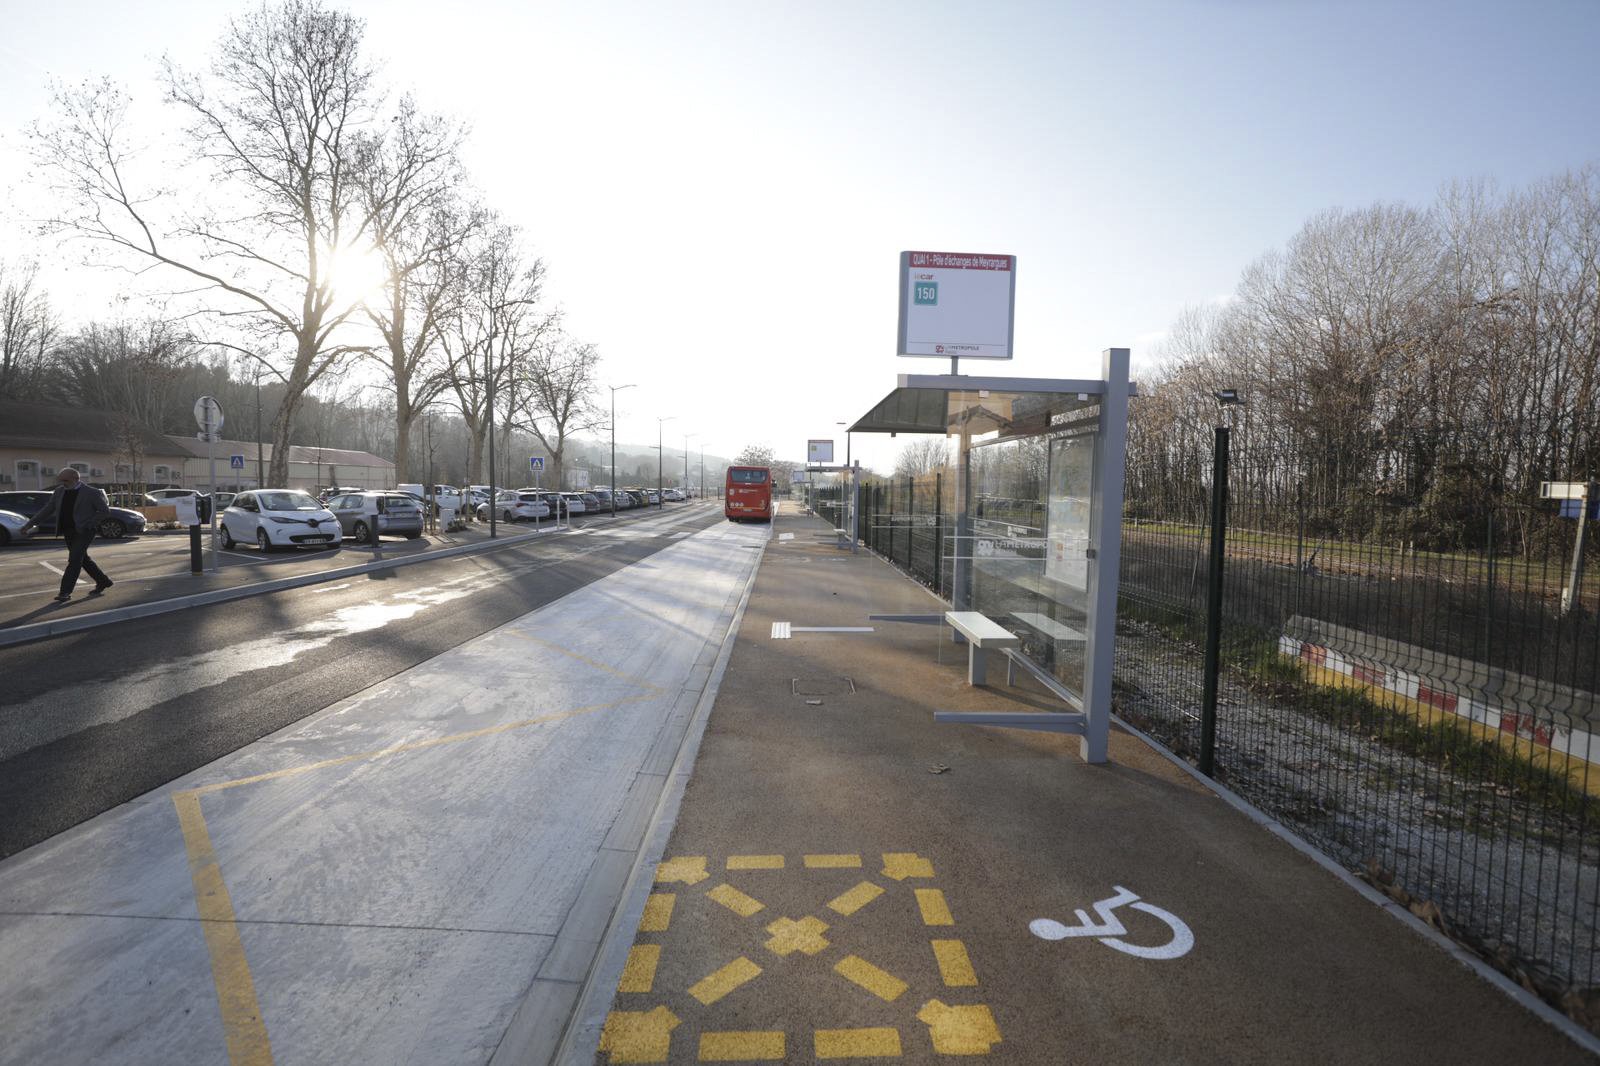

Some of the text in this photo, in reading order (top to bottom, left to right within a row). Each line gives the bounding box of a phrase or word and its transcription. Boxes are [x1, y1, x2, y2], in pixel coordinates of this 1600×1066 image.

[913, 253, 926, 265] QUAI
[972, 256, 979, 267] de
[917, 287, 935, 300] 150
